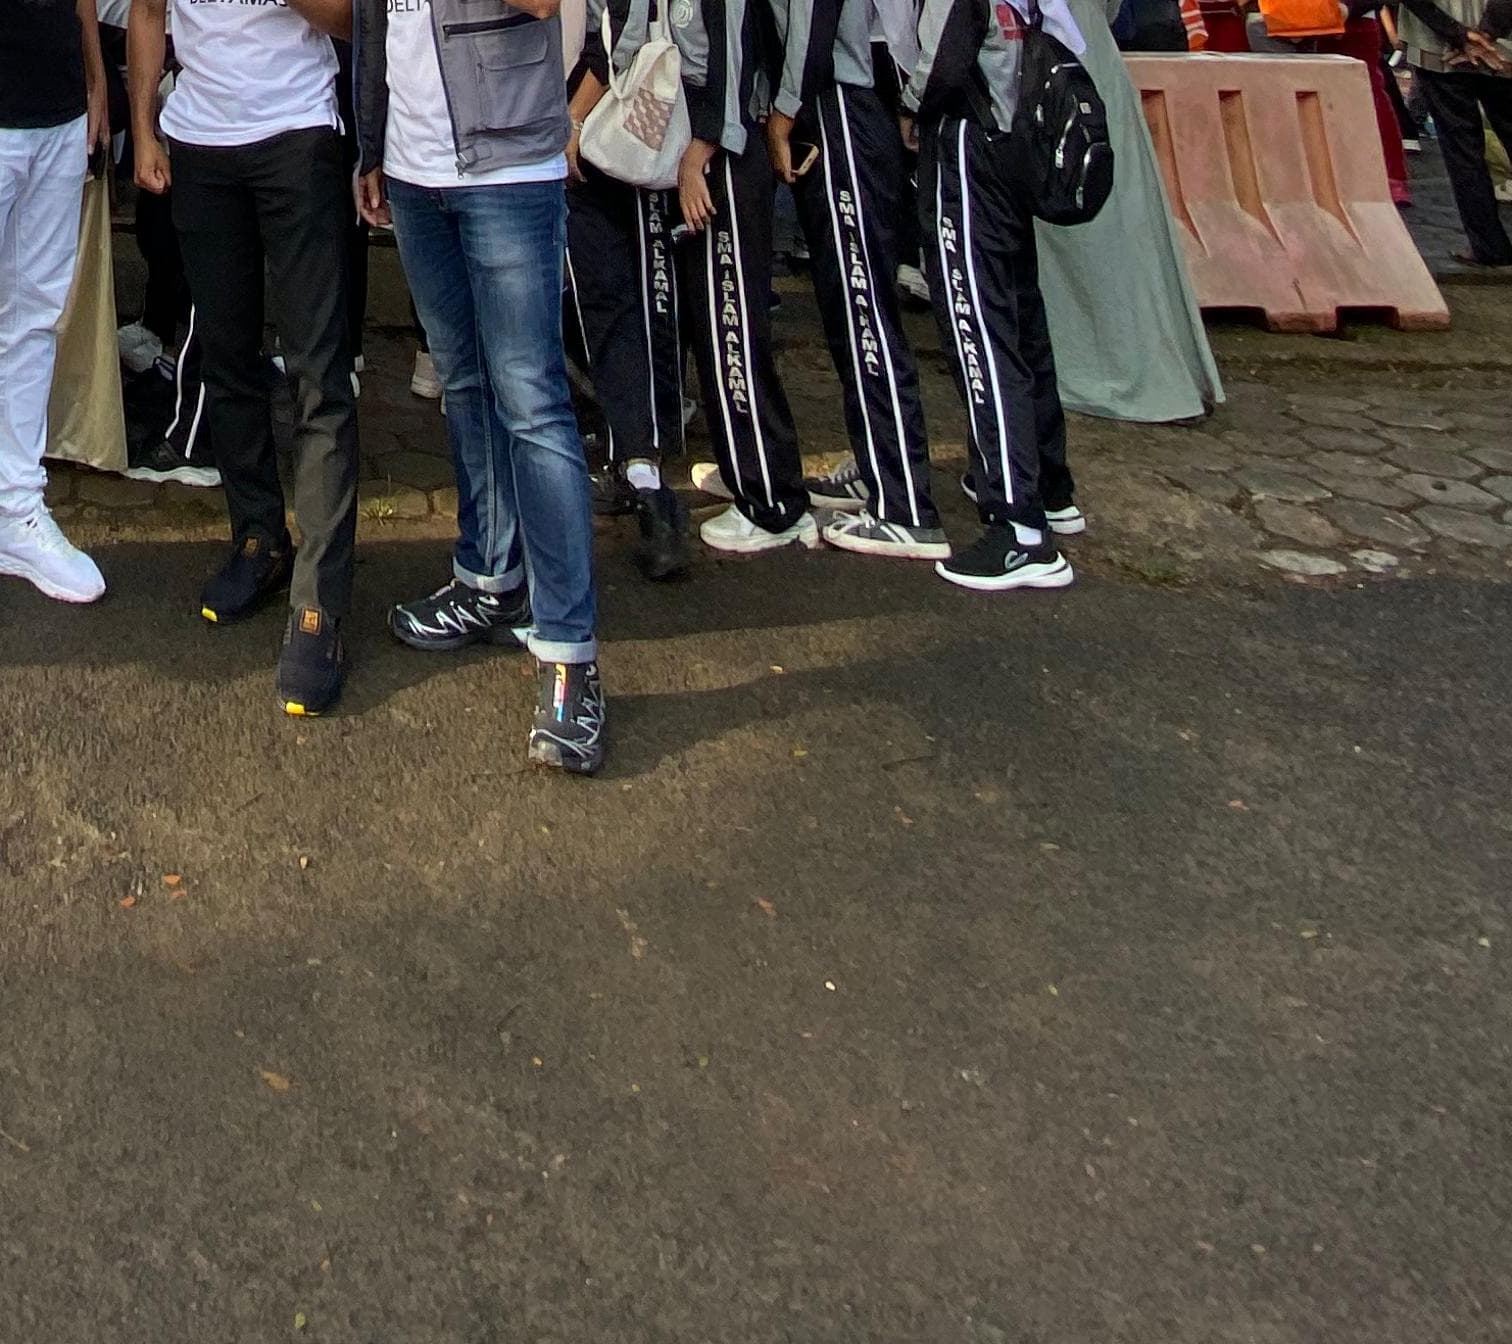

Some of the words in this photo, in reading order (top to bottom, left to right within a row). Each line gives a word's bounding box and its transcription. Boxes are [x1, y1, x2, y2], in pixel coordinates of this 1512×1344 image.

[717, 230, 733, 266] SMA
[942, 215, 957, 254] SMA
[653, 239, 670, 313] ALKAMAL
[722, 269, 739, 327] ISLAM
[839, 190, 856, 228] SMA
[855, 294, 880, 377] AKAMAL
[725, 330, 750, 414] ALKAMAL
